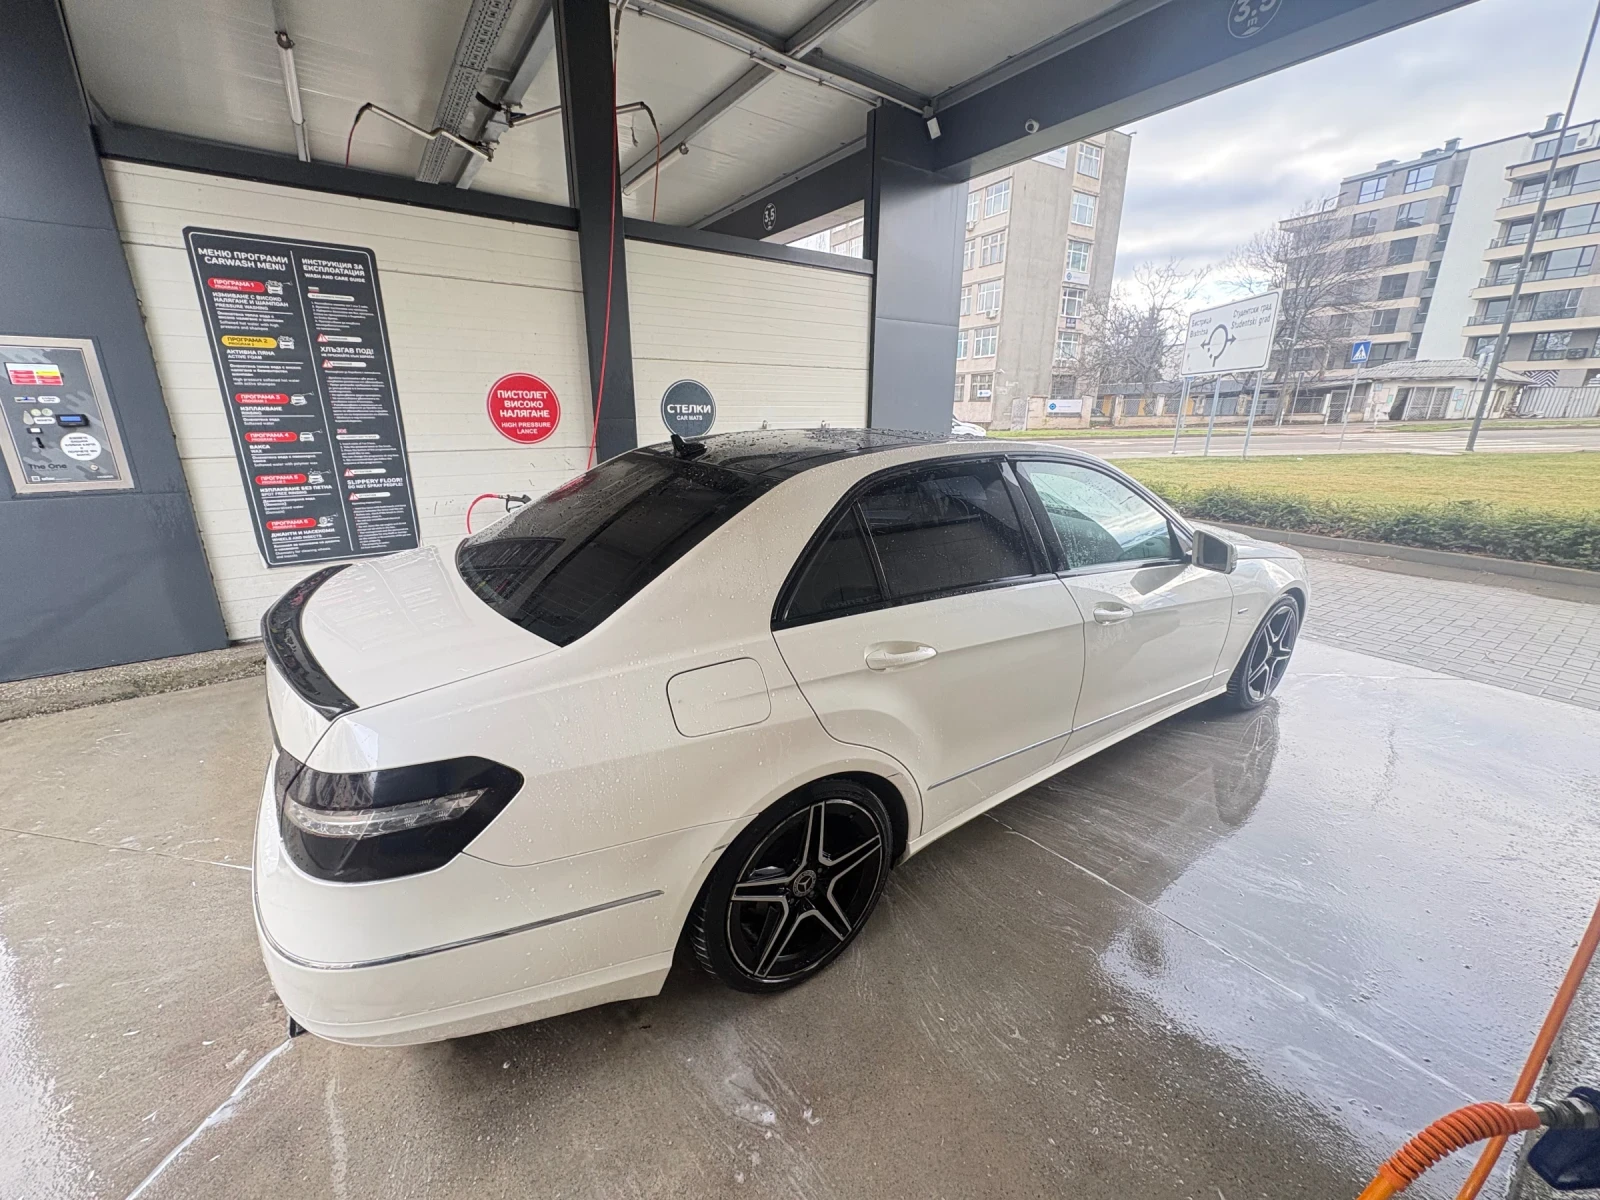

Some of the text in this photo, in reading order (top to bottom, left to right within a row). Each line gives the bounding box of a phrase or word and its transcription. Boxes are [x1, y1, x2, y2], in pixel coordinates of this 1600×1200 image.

[764, 208, 774, 222] 3.5
[198, 248, 288, 264] МЕНЮ ПРОГРАМИ
[204, 256, 286, 271] CARWASH MENU
[302, 258, 352, 269] ИНСТРУКЦИЯ
[303, 265, 365, 276] ЕКСПЛОАТАЦИЯ
[1231, 314, 1271, 329] Studentski grad
[497, 390, 548, 399] ПИСТОЛЕТ
[504, 400, 544, 409] ВИСОКО
[667, 404, 711, 414] СТЕЛКИ
[500, 409, 550, 418] НАЛЯГАНЕ
